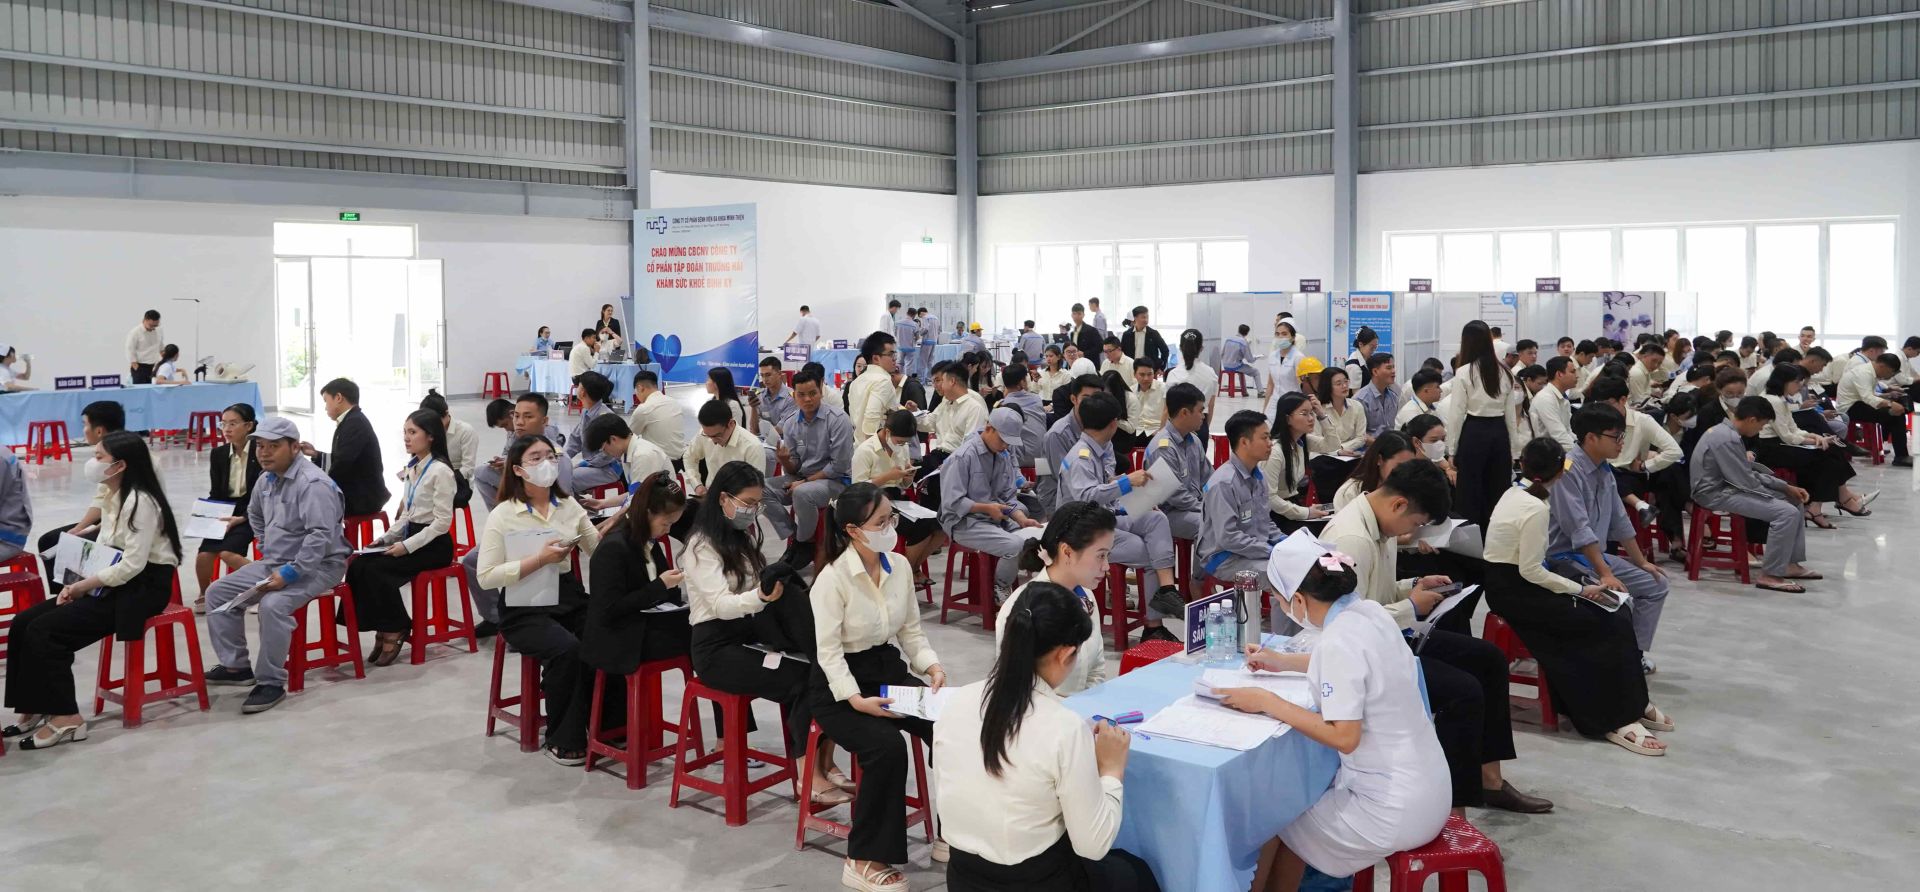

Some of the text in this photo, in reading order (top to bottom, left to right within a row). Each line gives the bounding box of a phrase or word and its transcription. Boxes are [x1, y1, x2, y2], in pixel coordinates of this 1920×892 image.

[651, 245, 667, 257] CHÀO
[669, 245, 686, 257] MỪNG
[688, 246, 708, 257] CBCNV
[656, 276, 674, 289] KHÁM
[675, 276, 687, 289] SỨC
